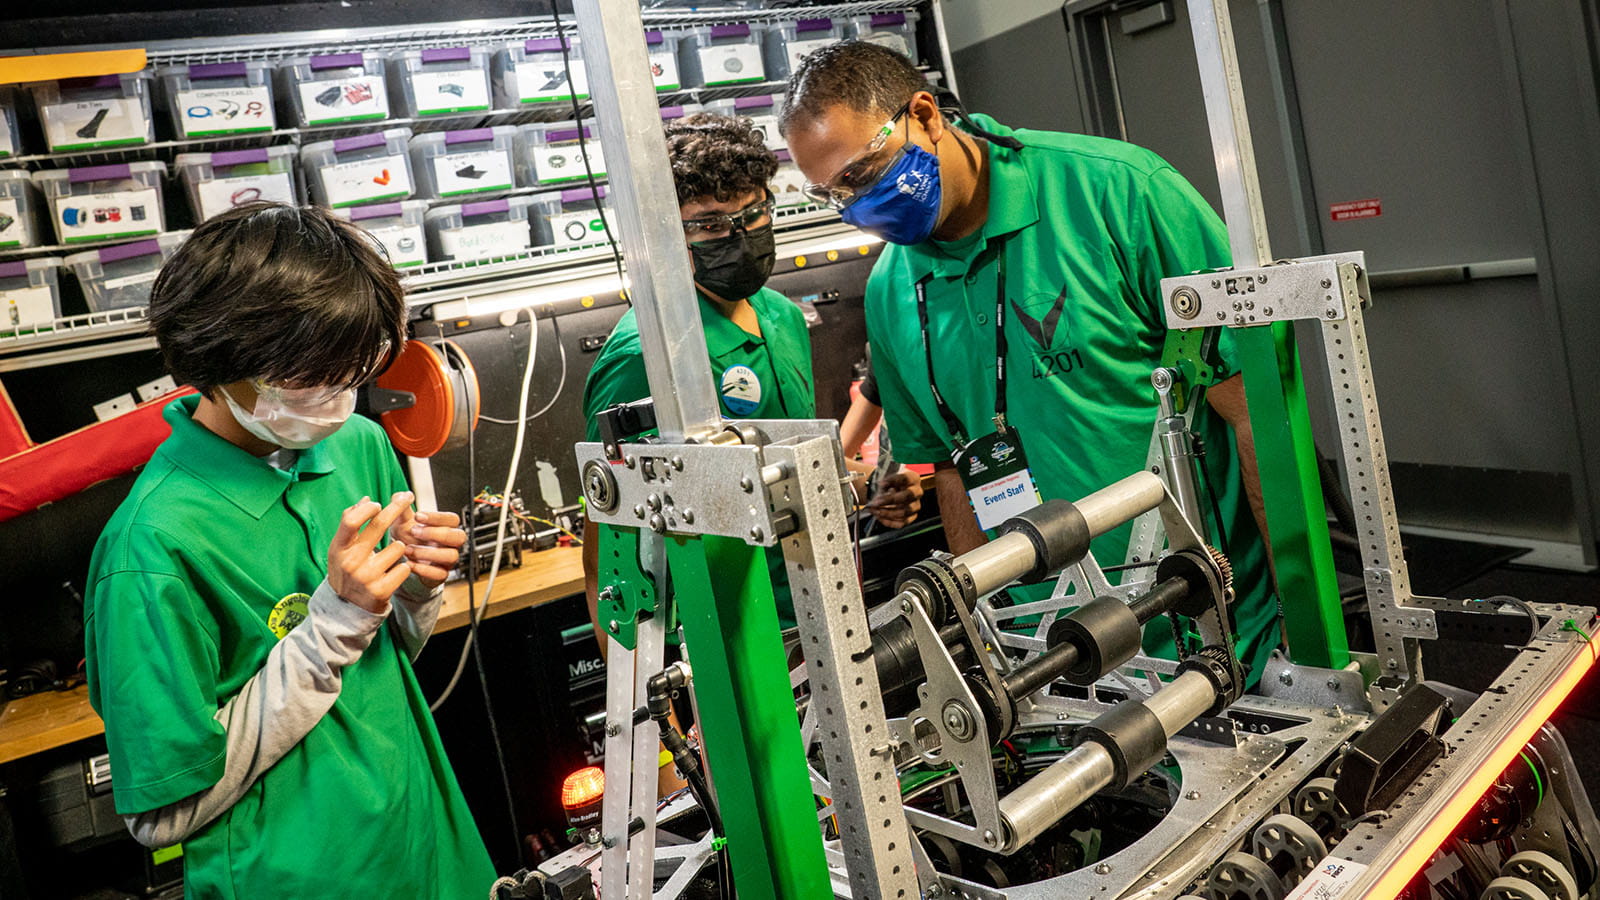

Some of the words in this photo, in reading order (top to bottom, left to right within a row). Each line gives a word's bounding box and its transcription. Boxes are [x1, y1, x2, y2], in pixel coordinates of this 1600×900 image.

[1031, 348, 1085, 380] 4201
[983, 491, 1006, 506] Event
[1006, 482, 1025, 497] Staff
[568, 658, 606, 677] Misc.
